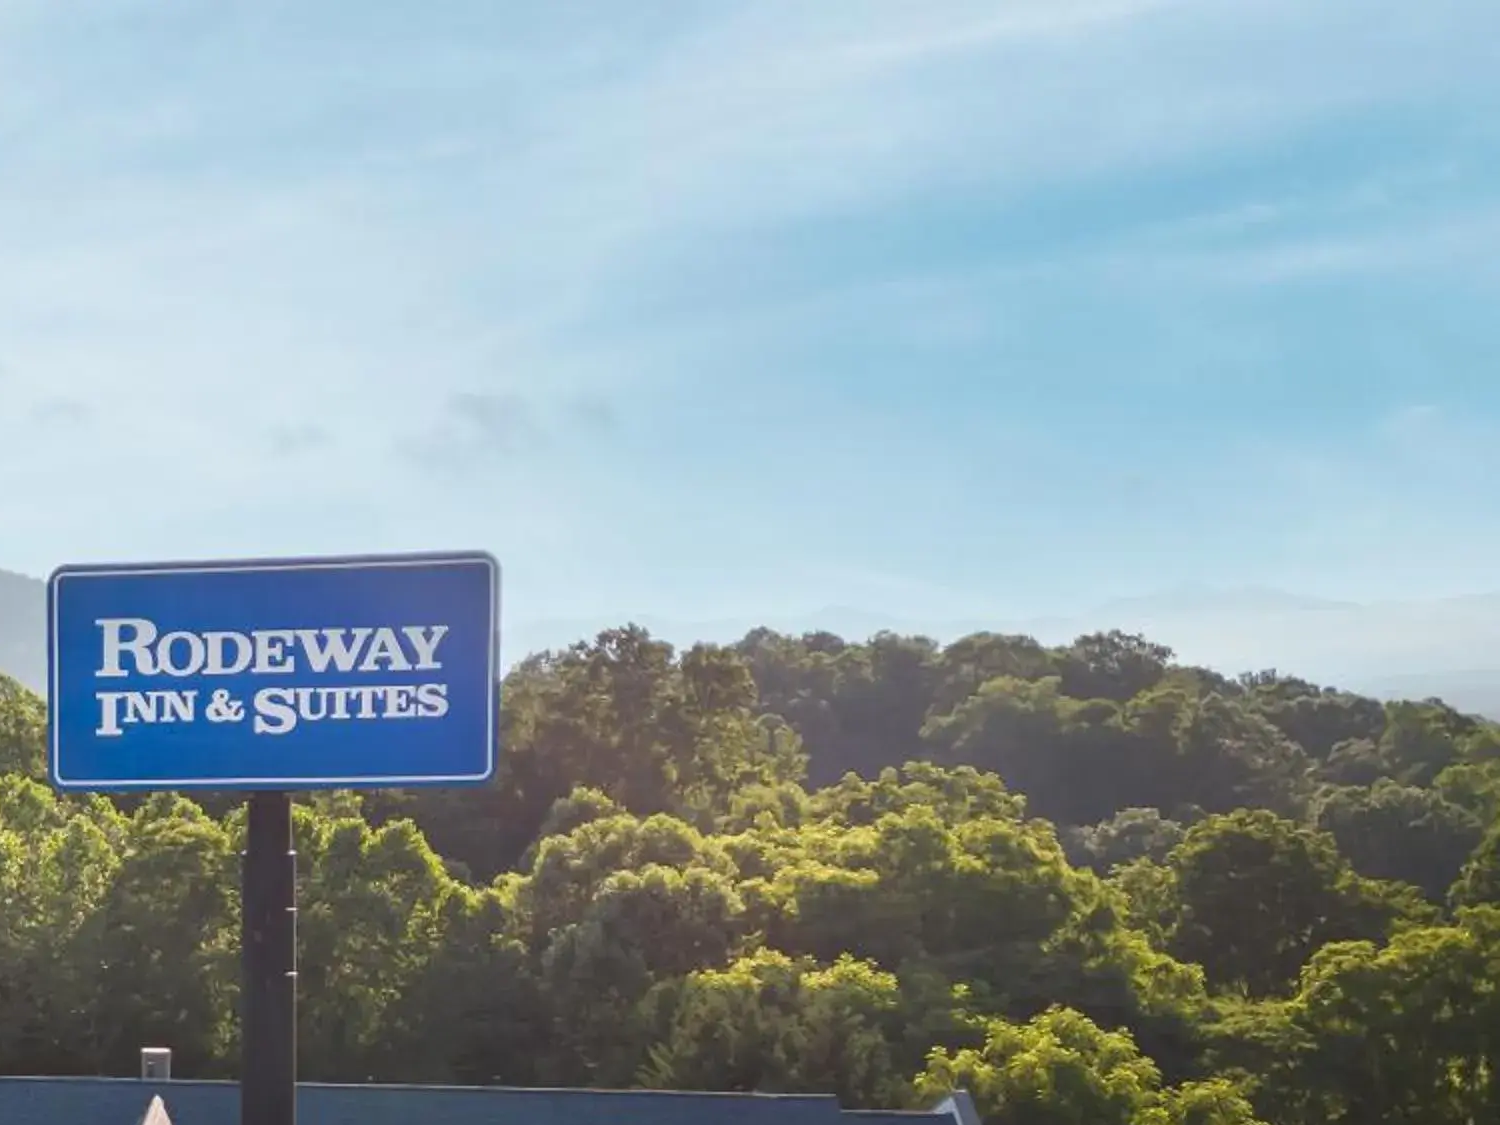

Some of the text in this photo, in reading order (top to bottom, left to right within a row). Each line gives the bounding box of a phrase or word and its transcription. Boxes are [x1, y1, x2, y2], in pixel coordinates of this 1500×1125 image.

[94, 618, 449, 677] RODEWAY
[95, 683, 449, 736] INN & SUITES
